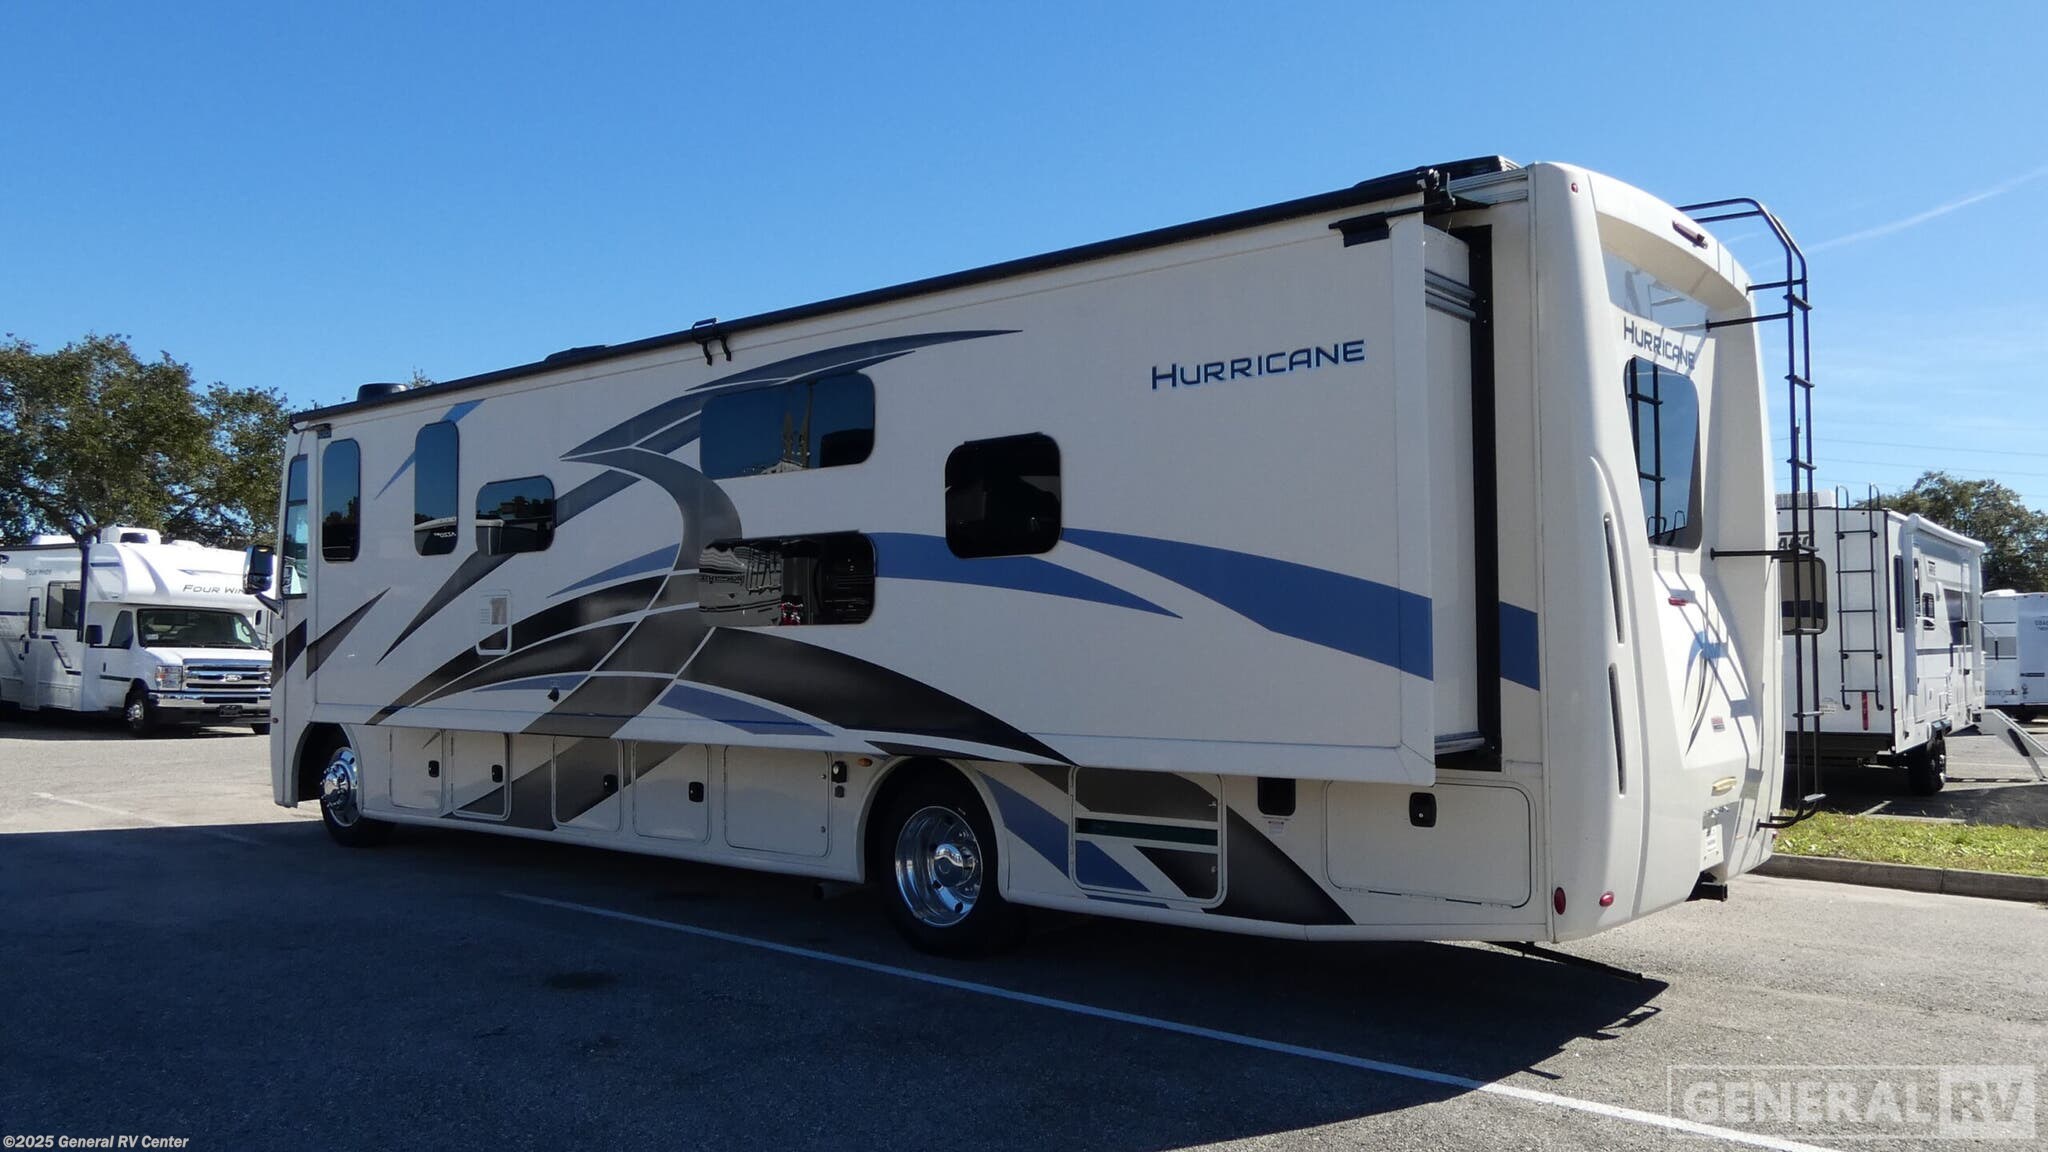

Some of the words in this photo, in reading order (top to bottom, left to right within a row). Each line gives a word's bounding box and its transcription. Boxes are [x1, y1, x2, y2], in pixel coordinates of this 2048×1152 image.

[1152, 339, 1366, 390] HURRICANE
[1623, 316, 1696, 370] HURRICANE
[182, 584, 220, 593] FOUR
